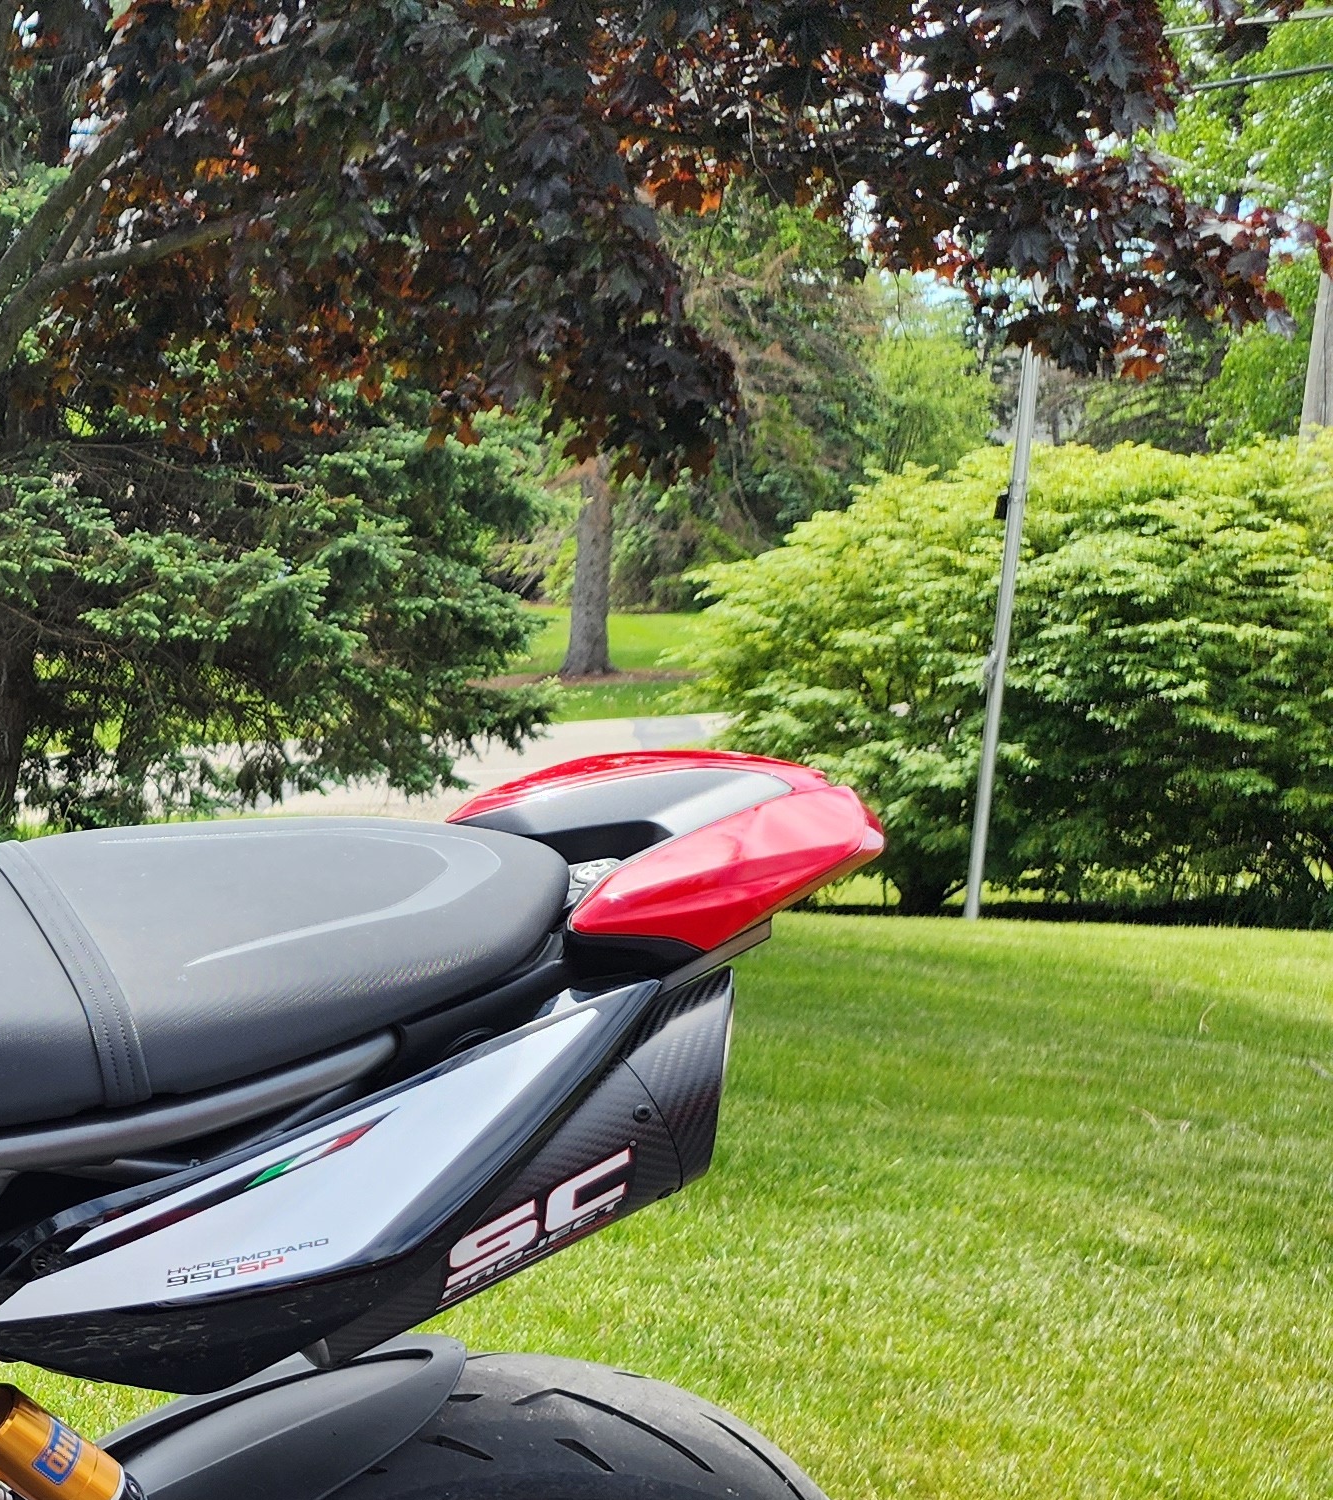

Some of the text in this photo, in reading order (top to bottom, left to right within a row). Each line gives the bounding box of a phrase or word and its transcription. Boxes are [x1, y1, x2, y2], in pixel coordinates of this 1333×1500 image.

[167, 1238, 329, 1276] HYPERMOTARD
[441, 1197, 623, 1300] PROJECT
[445, 1147, 631, 1288] SC
